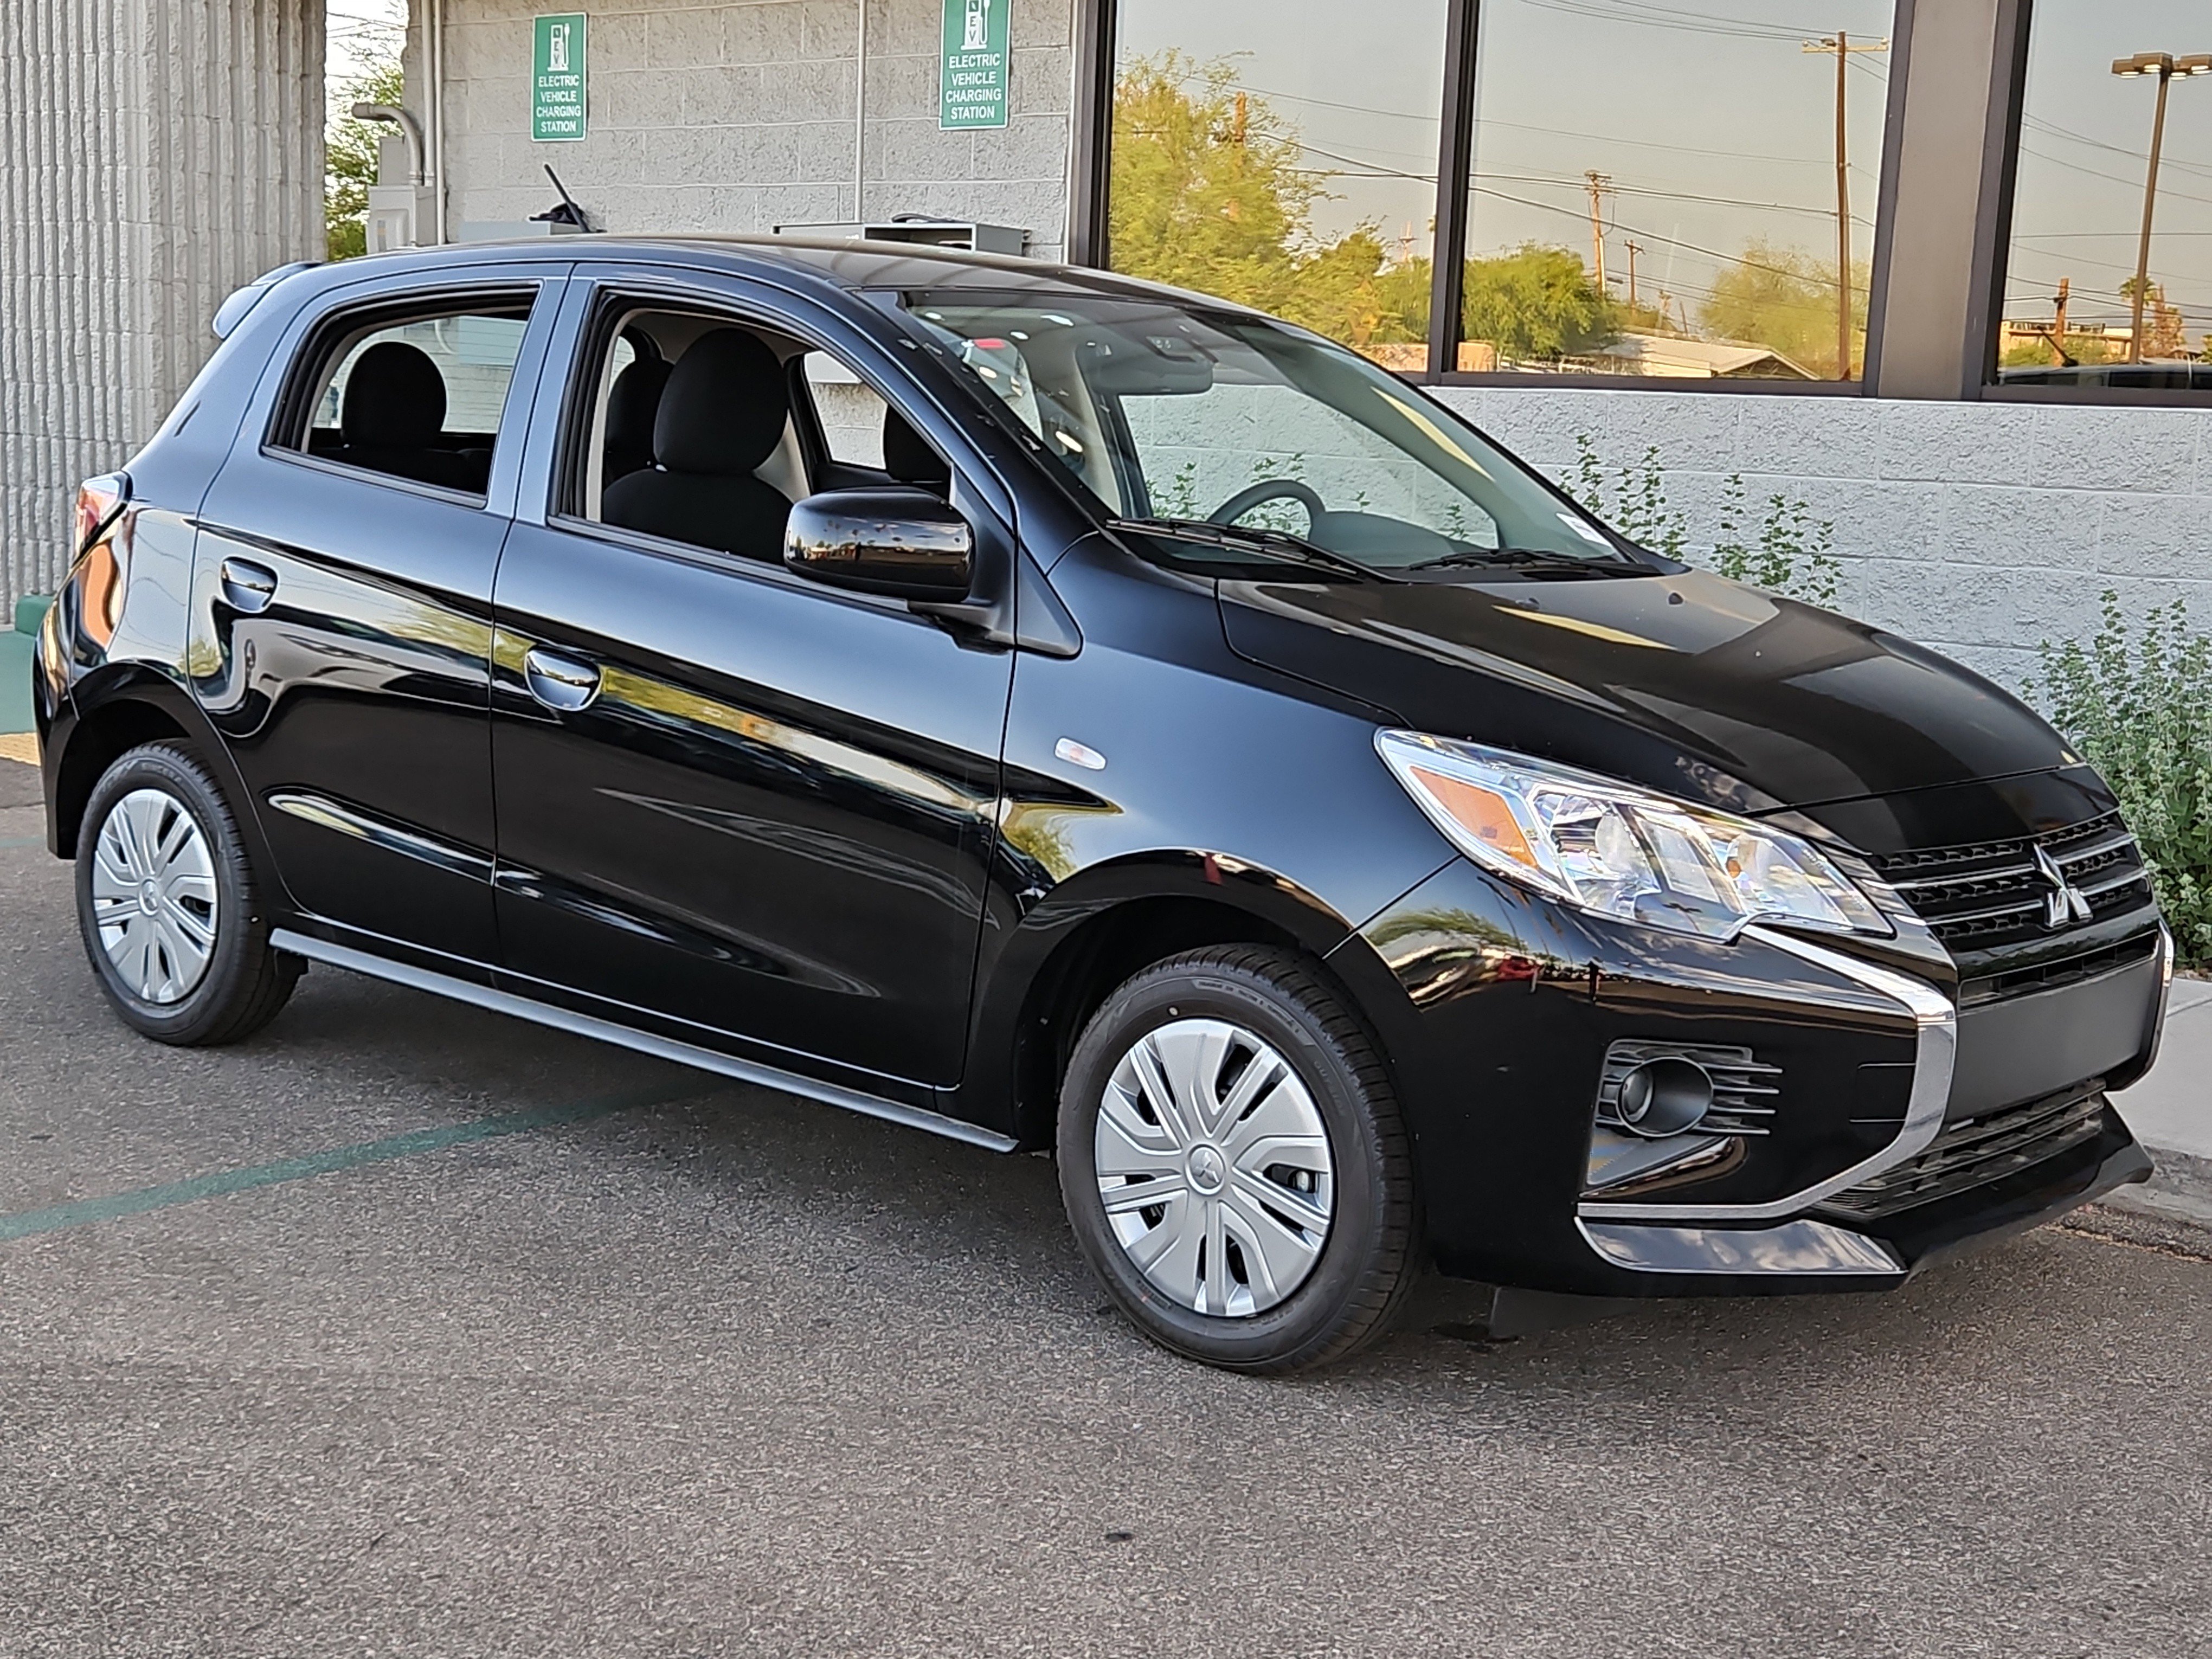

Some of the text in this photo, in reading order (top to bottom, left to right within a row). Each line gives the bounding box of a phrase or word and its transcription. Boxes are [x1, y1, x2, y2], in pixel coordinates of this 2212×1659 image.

[949, 53, 1000, 68] ELECTRIC
[538, 75, 580, 87] ELECTRIC
[951, 71, 996, 86] VEHICLE
[540, 91, 577, 102] VEHICLE
[946, 88, 1001, 102] CHARGING
[536, 105, 581, 117] CHARGING
[950, 105, 995, 119] STATION
[541, 120, 576, 132] STATION
